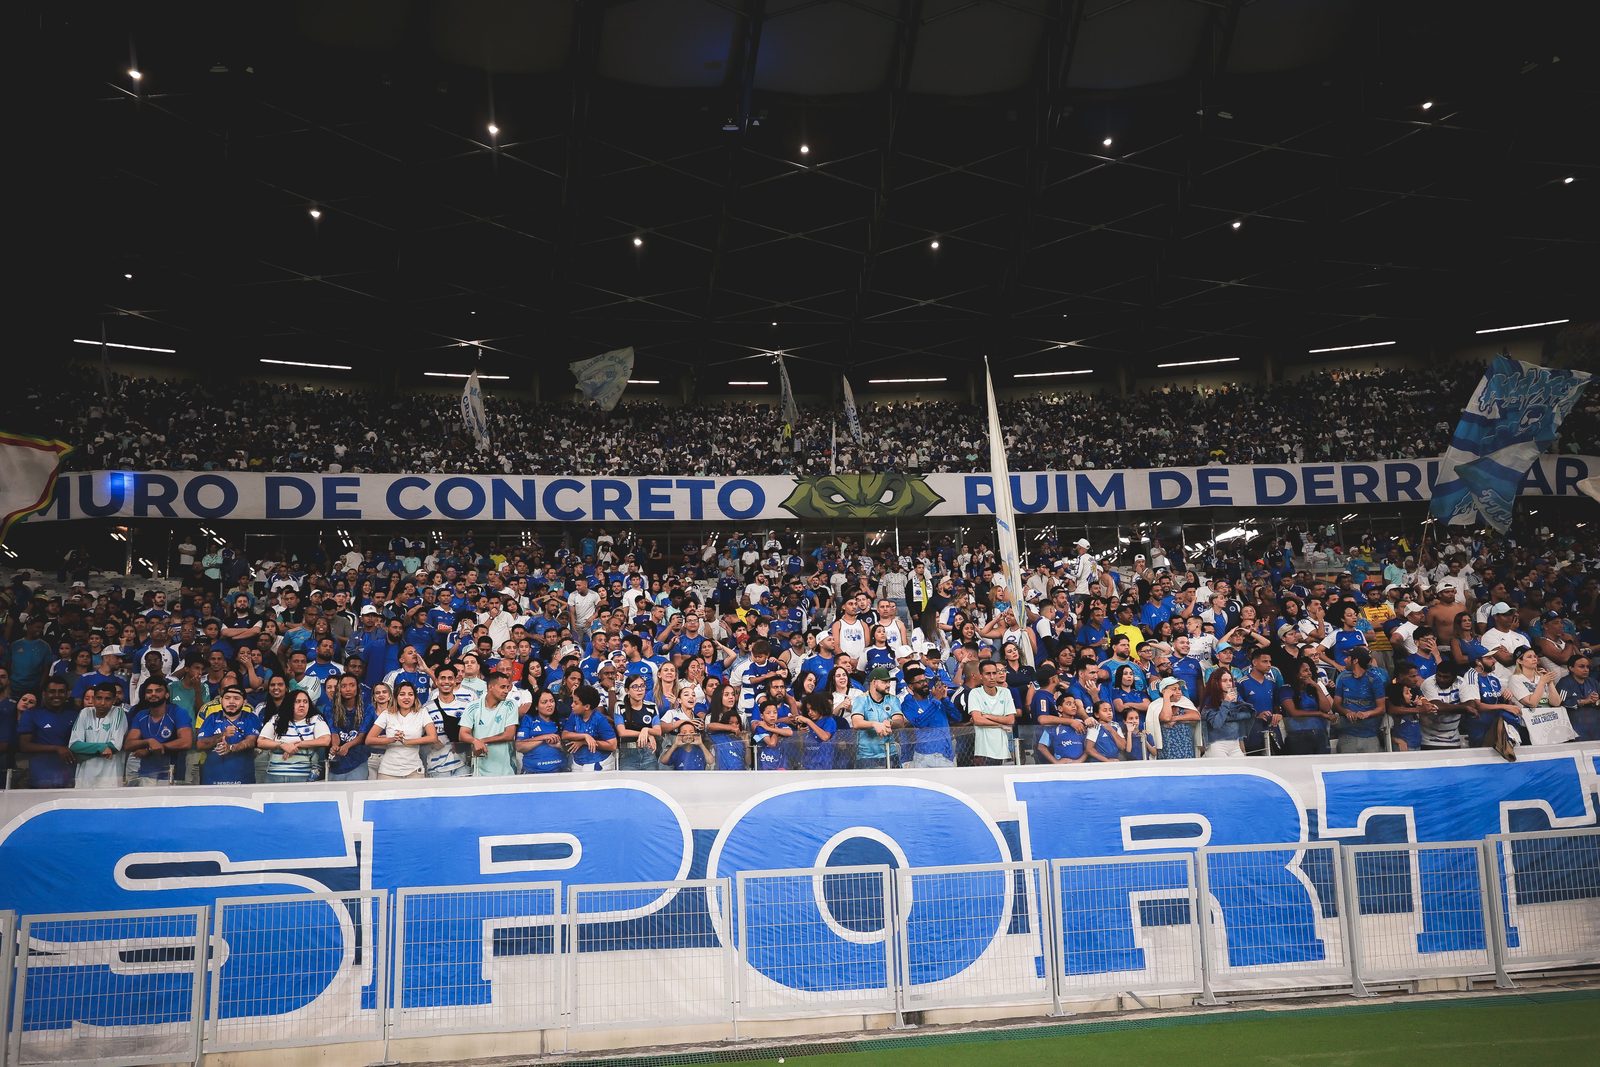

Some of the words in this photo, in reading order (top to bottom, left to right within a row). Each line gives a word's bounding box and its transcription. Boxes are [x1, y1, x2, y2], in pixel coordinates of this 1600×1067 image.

[265, 476, 362, 519] DE
[386, 476, 766, 520] CONCRETO
[964, 472, 1127, 514] RUIM
[1149, 470, 1233, 508] DE
[1251, 457, 1590, 506] DERRAR
[0, 750, 1600, 1034] SPORT
